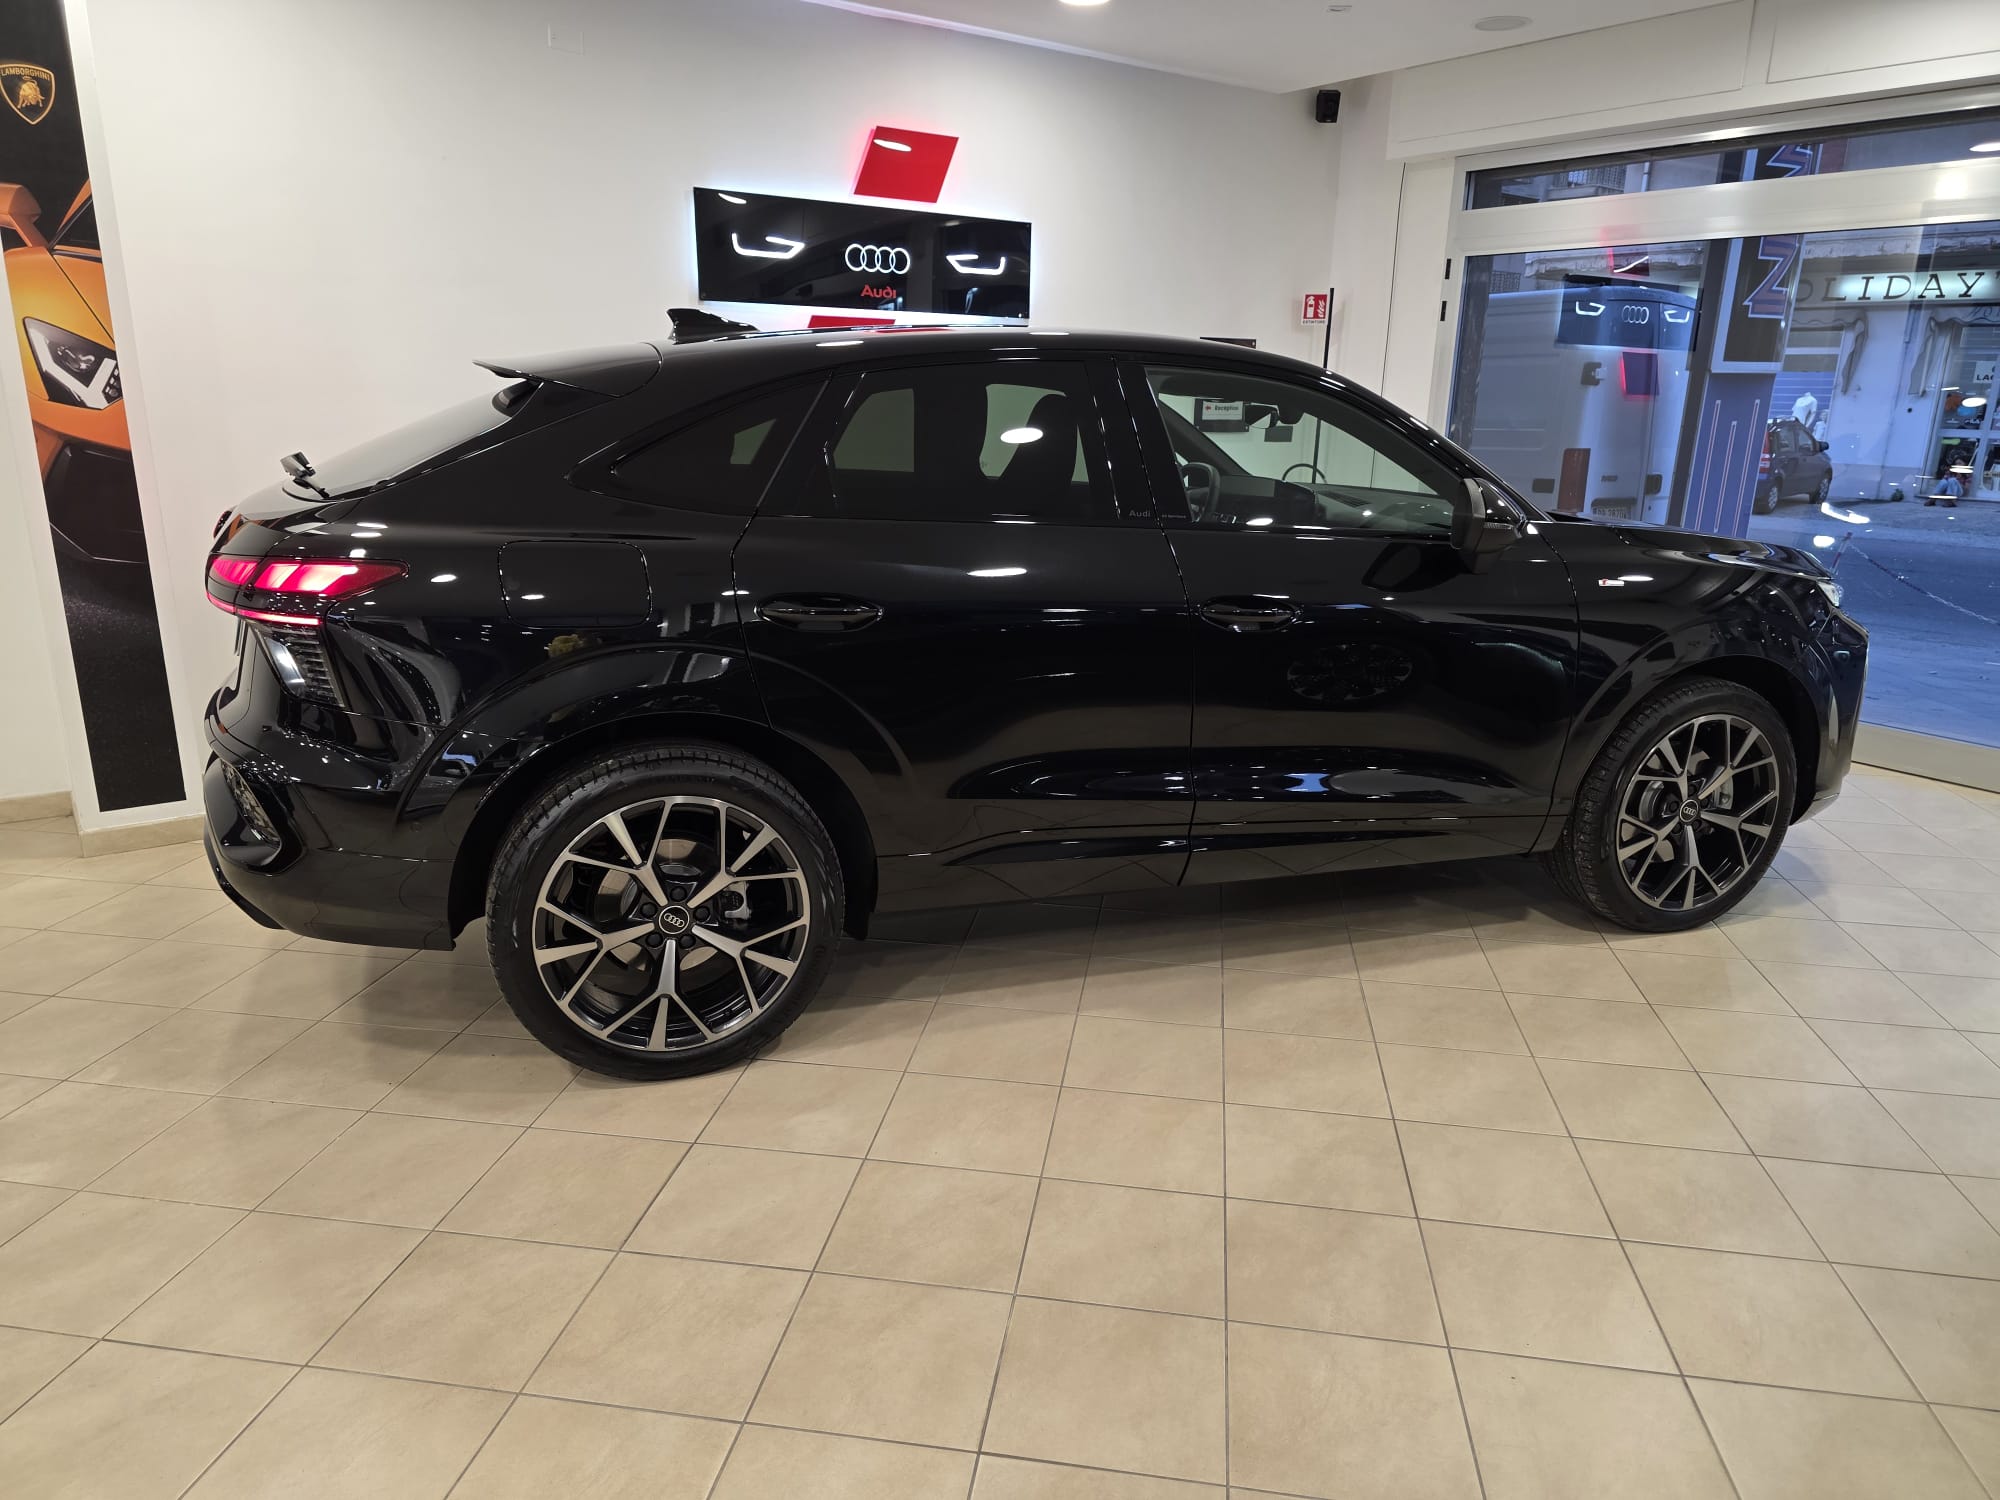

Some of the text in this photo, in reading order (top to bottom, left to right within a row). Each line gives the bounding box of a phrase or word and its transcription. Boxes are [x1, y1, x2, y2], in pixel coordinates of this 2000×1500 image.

[1, 67, 51, 80] LAMBORGHINI
[860, 284, 897, 299] Audi
[1129, 509, 1151, 518] Audi
